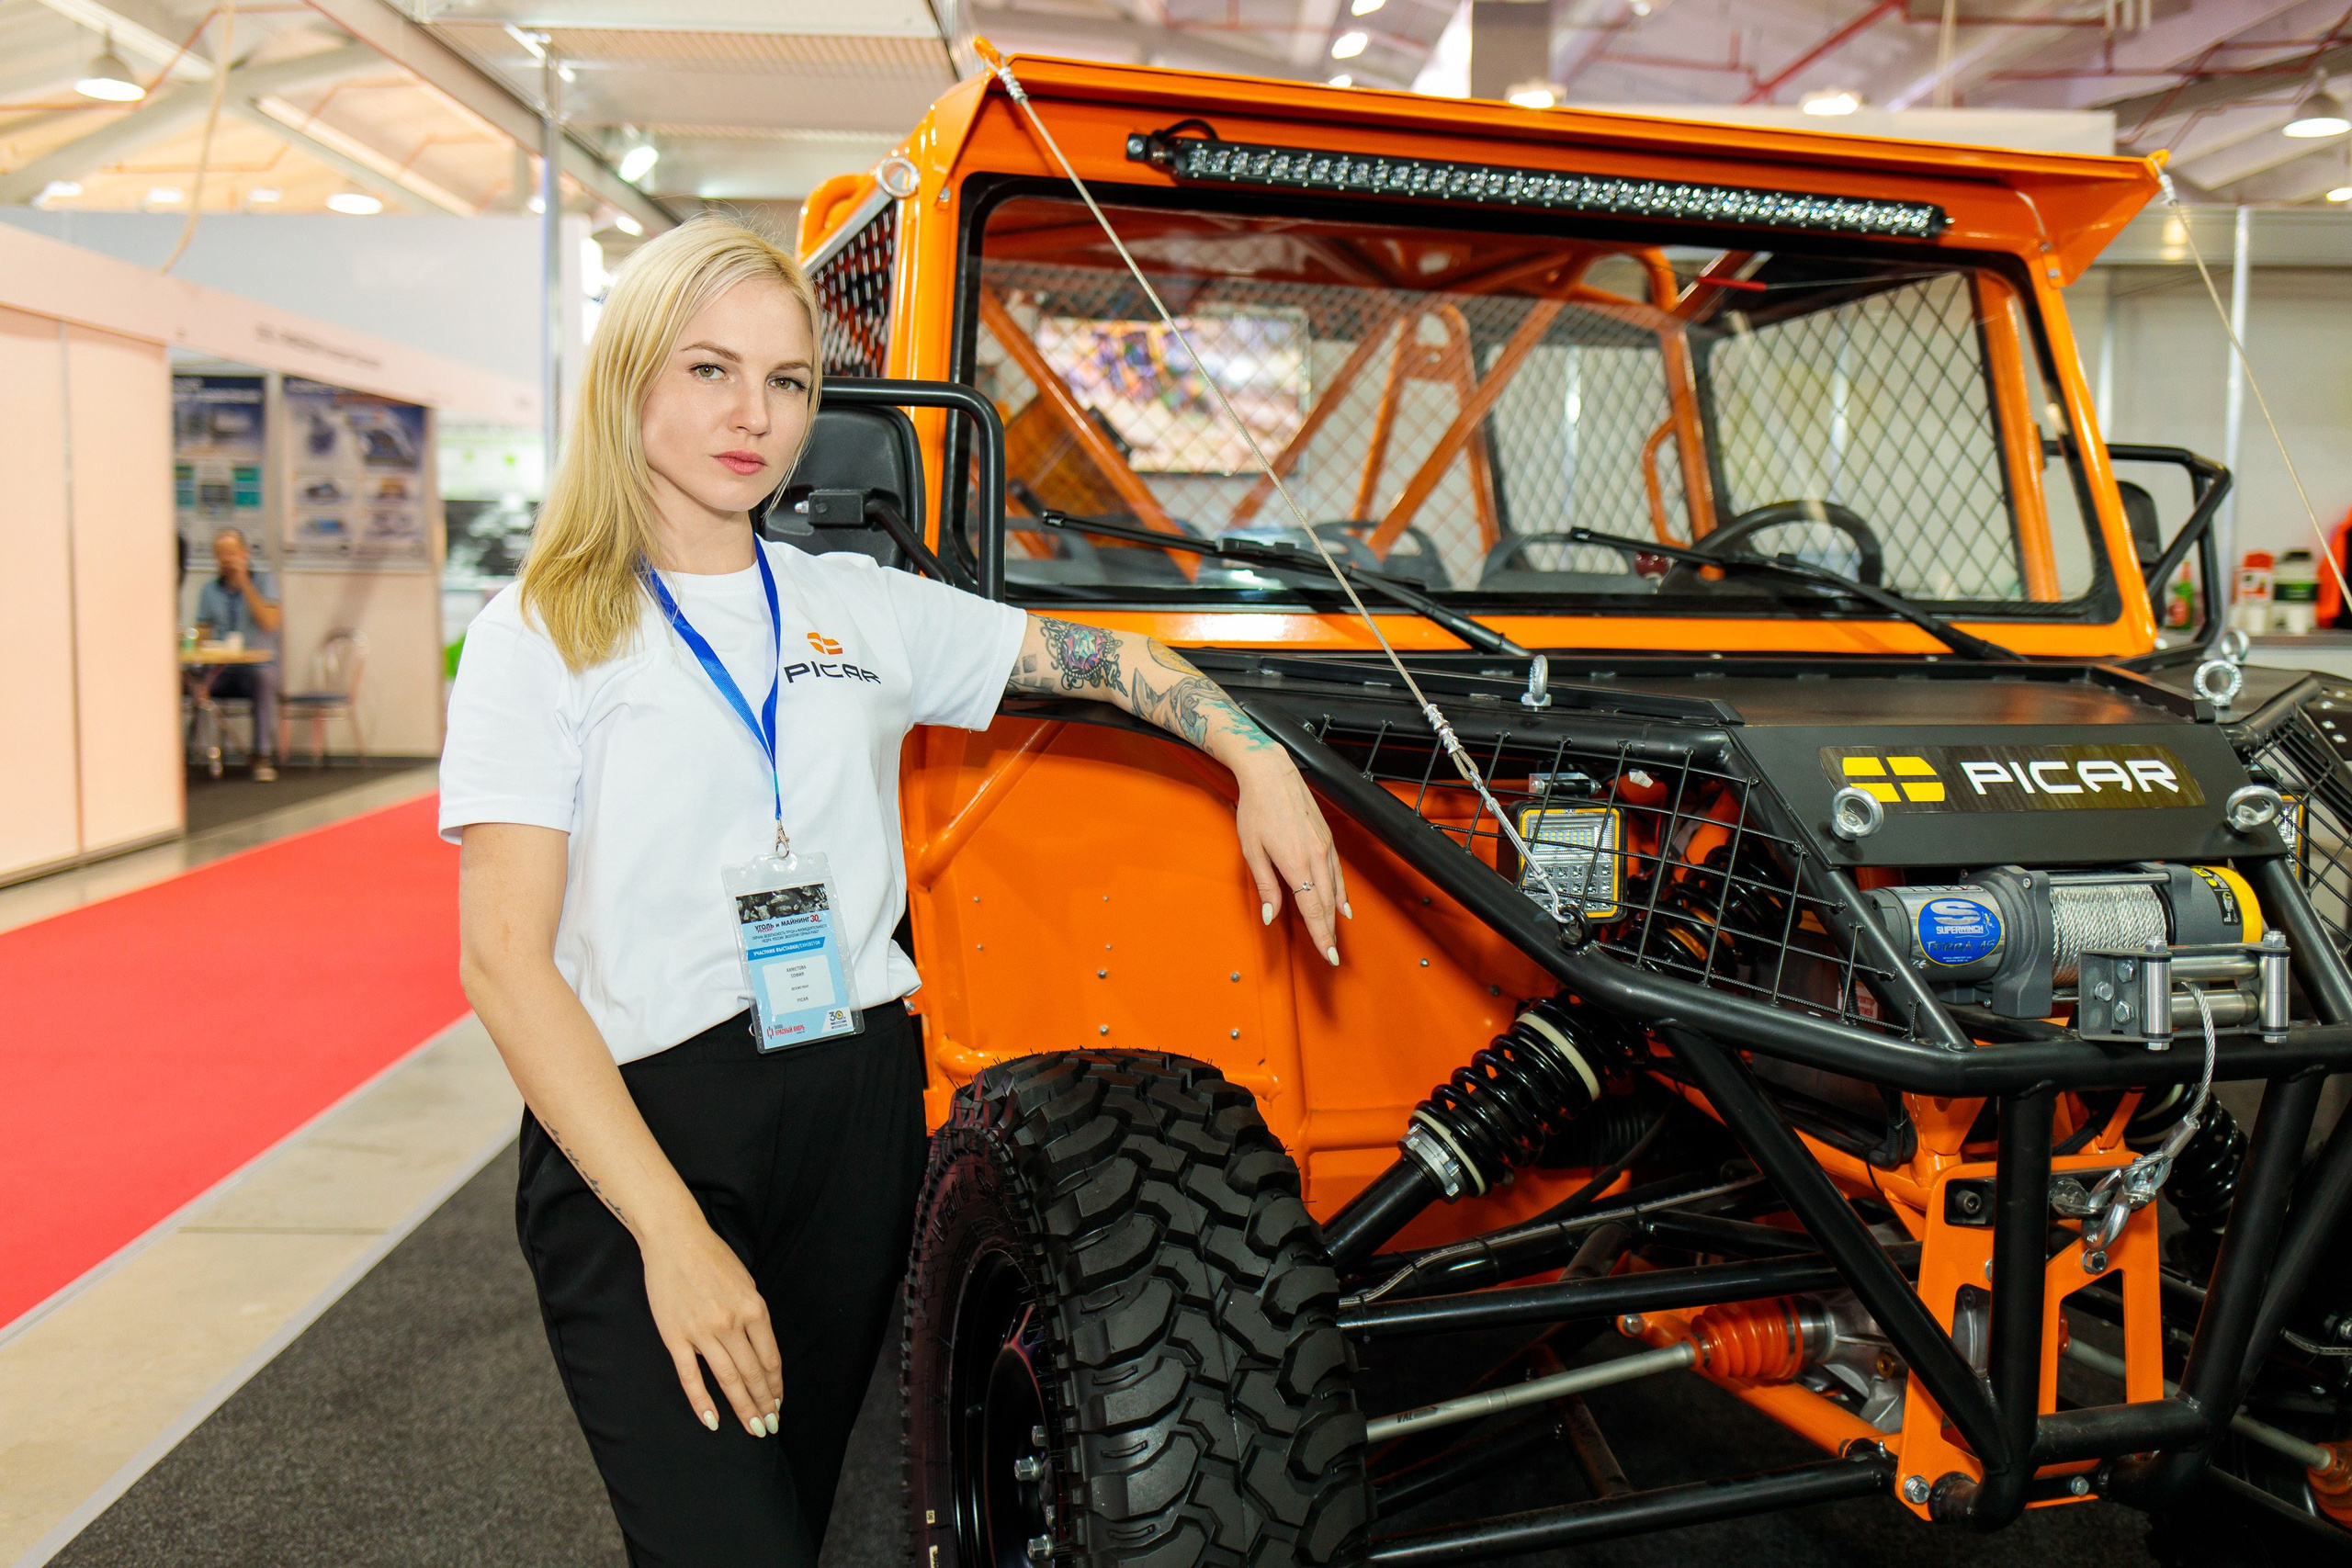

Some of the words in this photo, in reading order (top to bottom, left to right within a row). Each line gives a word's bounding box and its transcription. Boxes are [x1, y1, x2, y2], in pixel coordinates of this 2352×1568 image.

[784, 660, 881, 684] PICAR
[1960, 760, 2179, 795] PICAR
[781, 917, 809, 927] МАЙНИНГ
[810, 914, 819, 923] 30
[1936, 925, 1984, 935] SUPERWINCH
[1926, 941, 1973, 953] TERRA
